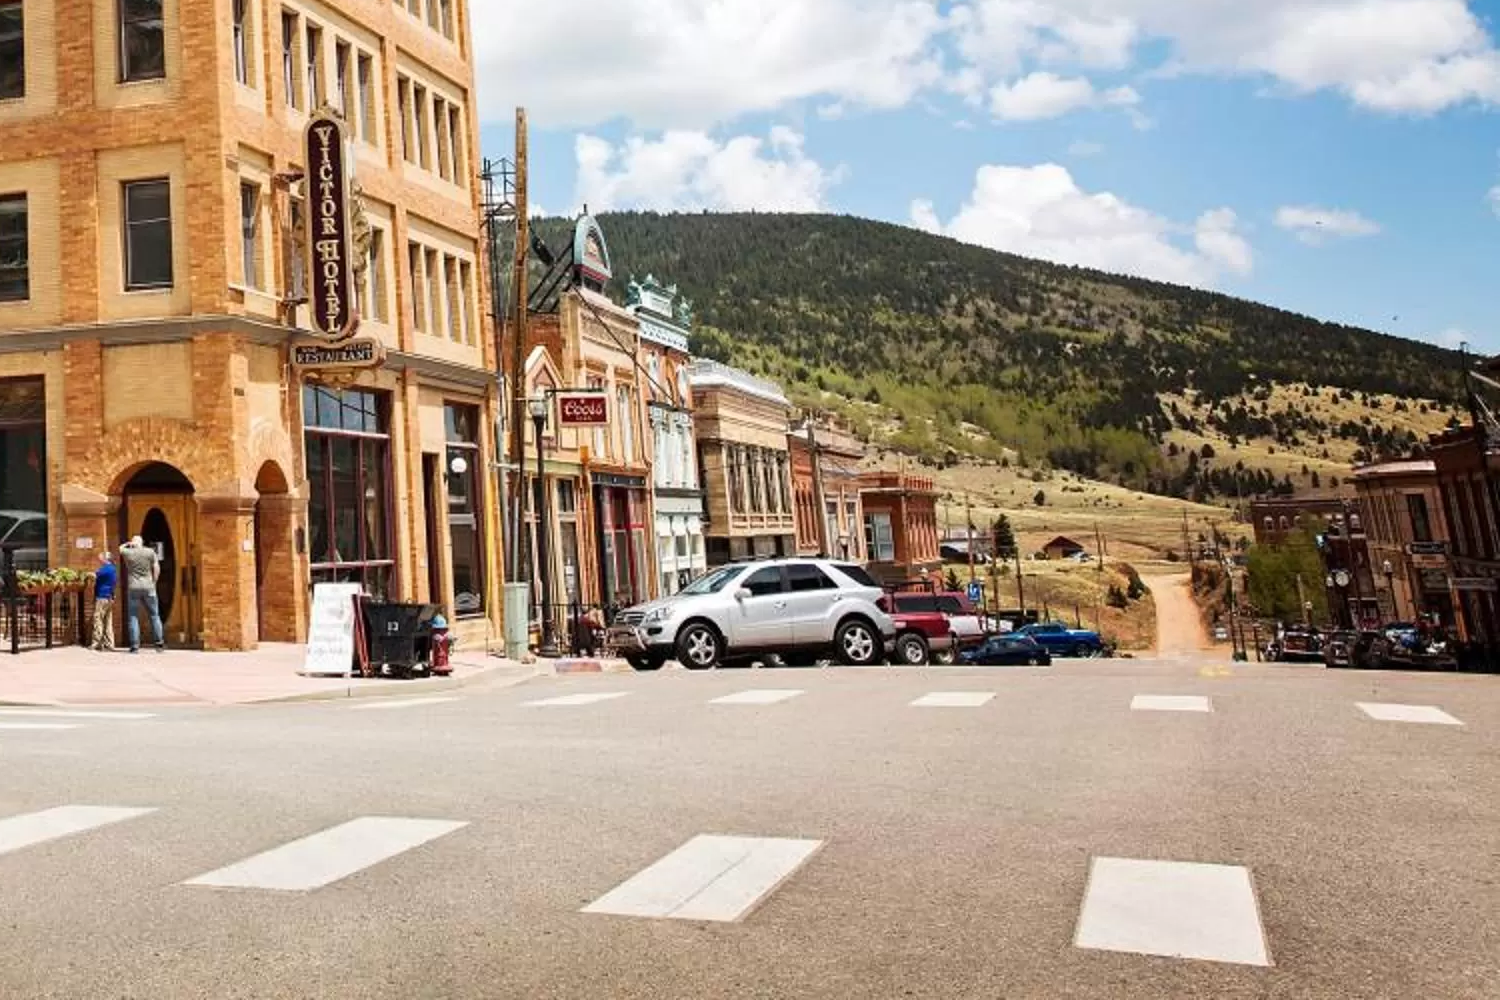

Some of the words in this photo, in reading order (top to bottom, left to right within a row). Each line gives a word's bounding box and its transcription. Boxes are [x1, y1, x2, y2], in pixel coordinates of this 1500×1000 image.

[314, 126, 338, 235] VICTOR
[316, 239, 341, 334] HOTEL
[297, 349, 373, 363] RESTAURANT
[564, 400, 603, 416] Coors
